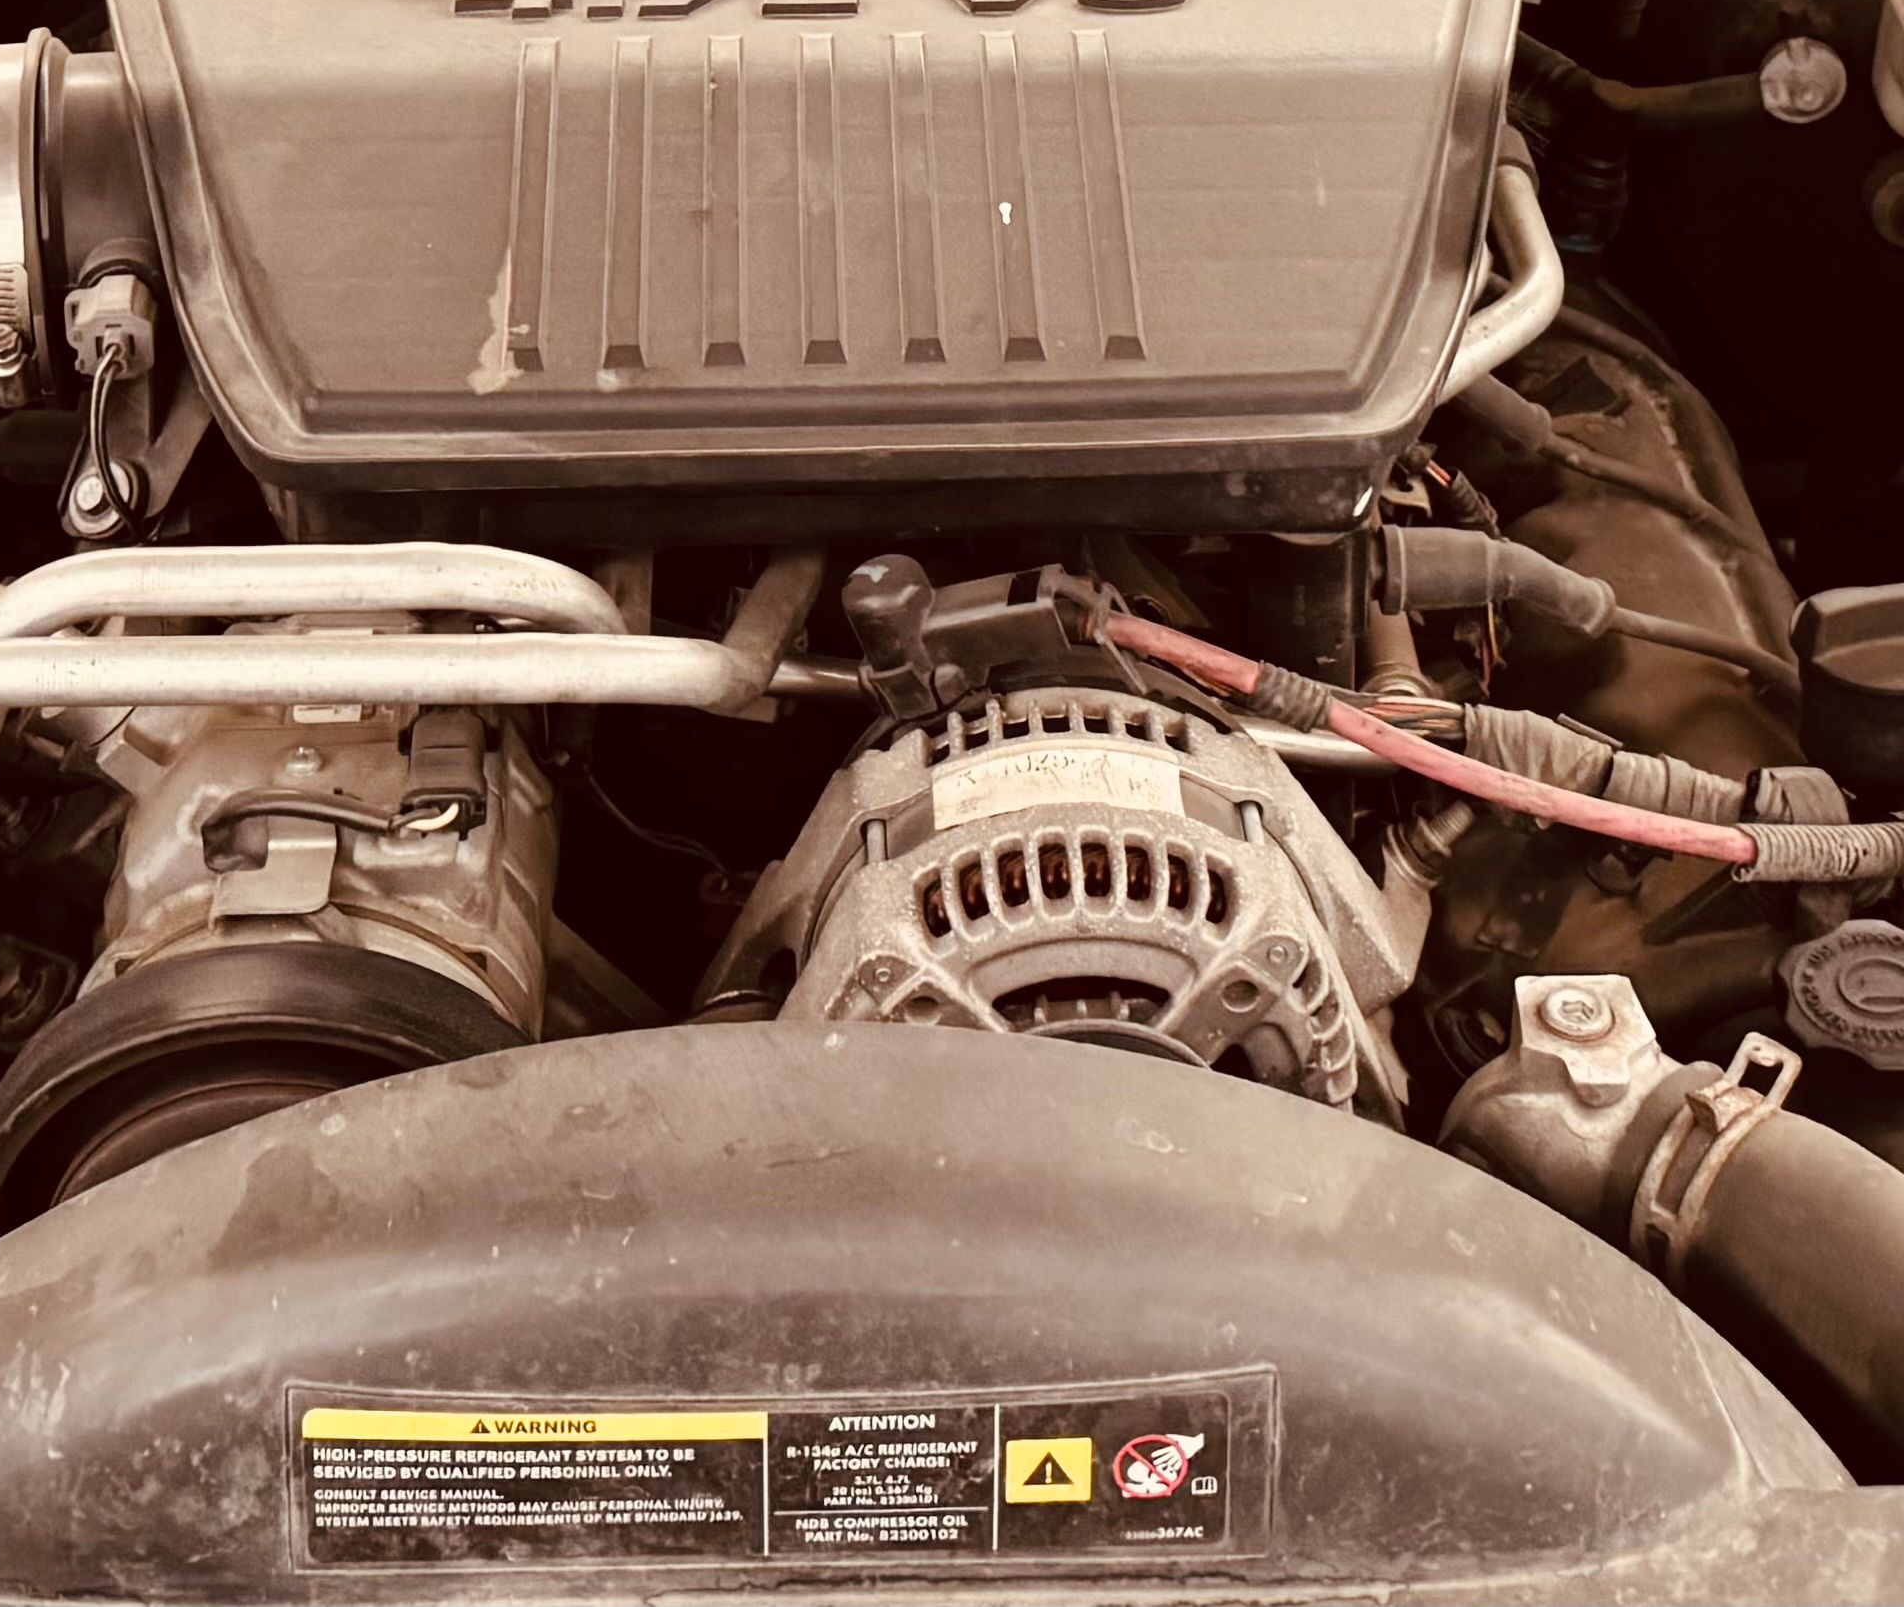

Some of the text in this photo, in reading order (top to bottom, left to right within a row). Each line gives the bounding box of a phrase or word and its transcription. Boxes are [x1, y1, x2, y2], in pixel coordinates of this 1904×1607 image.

[494, 1420, 597, 1434] WARNING
[828, 1414, 936, 1432] ATTENTION
[313, 1448, 695, 1463] HIGH-PRESSURE REFRIGERANT SYSTEM TO BE
[845, 1443, 874, 1457] A/C
[878, 1441, 979, 1456] REFRIGERANT
[813, 1457, 881, 1471] FACTORY
[313, 1465, 673, 1480] SERVICED BY QUALIFIED PERSONNEL ONLY.
[314, 1489, 504, 1500] CONSULT SERVICE MANUAL.
[315, 1502, 386, 1514] IMPROPER
[388, 1502, 445, 1513] SERVICE
[448, 1502, 516, 1513] METHODS
[518, 1502, 548, 1513] MAY
[551, 1501, 596, 1512] CAUSE
[599, 1499, 671, 1511] PERSONAL
[315, 1516, 370, 1527] SYSTEM
[372, 1515, 418, 1527] MEETS
[421, 1515, 471, 1527] SAFETY
[474, 1513, 580, 1526] REQUIREMENTS
[583, 1512, 601, 1524] OF
[634, 1511, 707, 1523] STANDARD
[833, 1516, 938, 1529] COMPRESSOR
[942, 1515, 968, 1527] OIL
[805, 1531, 844, 1543] PART
